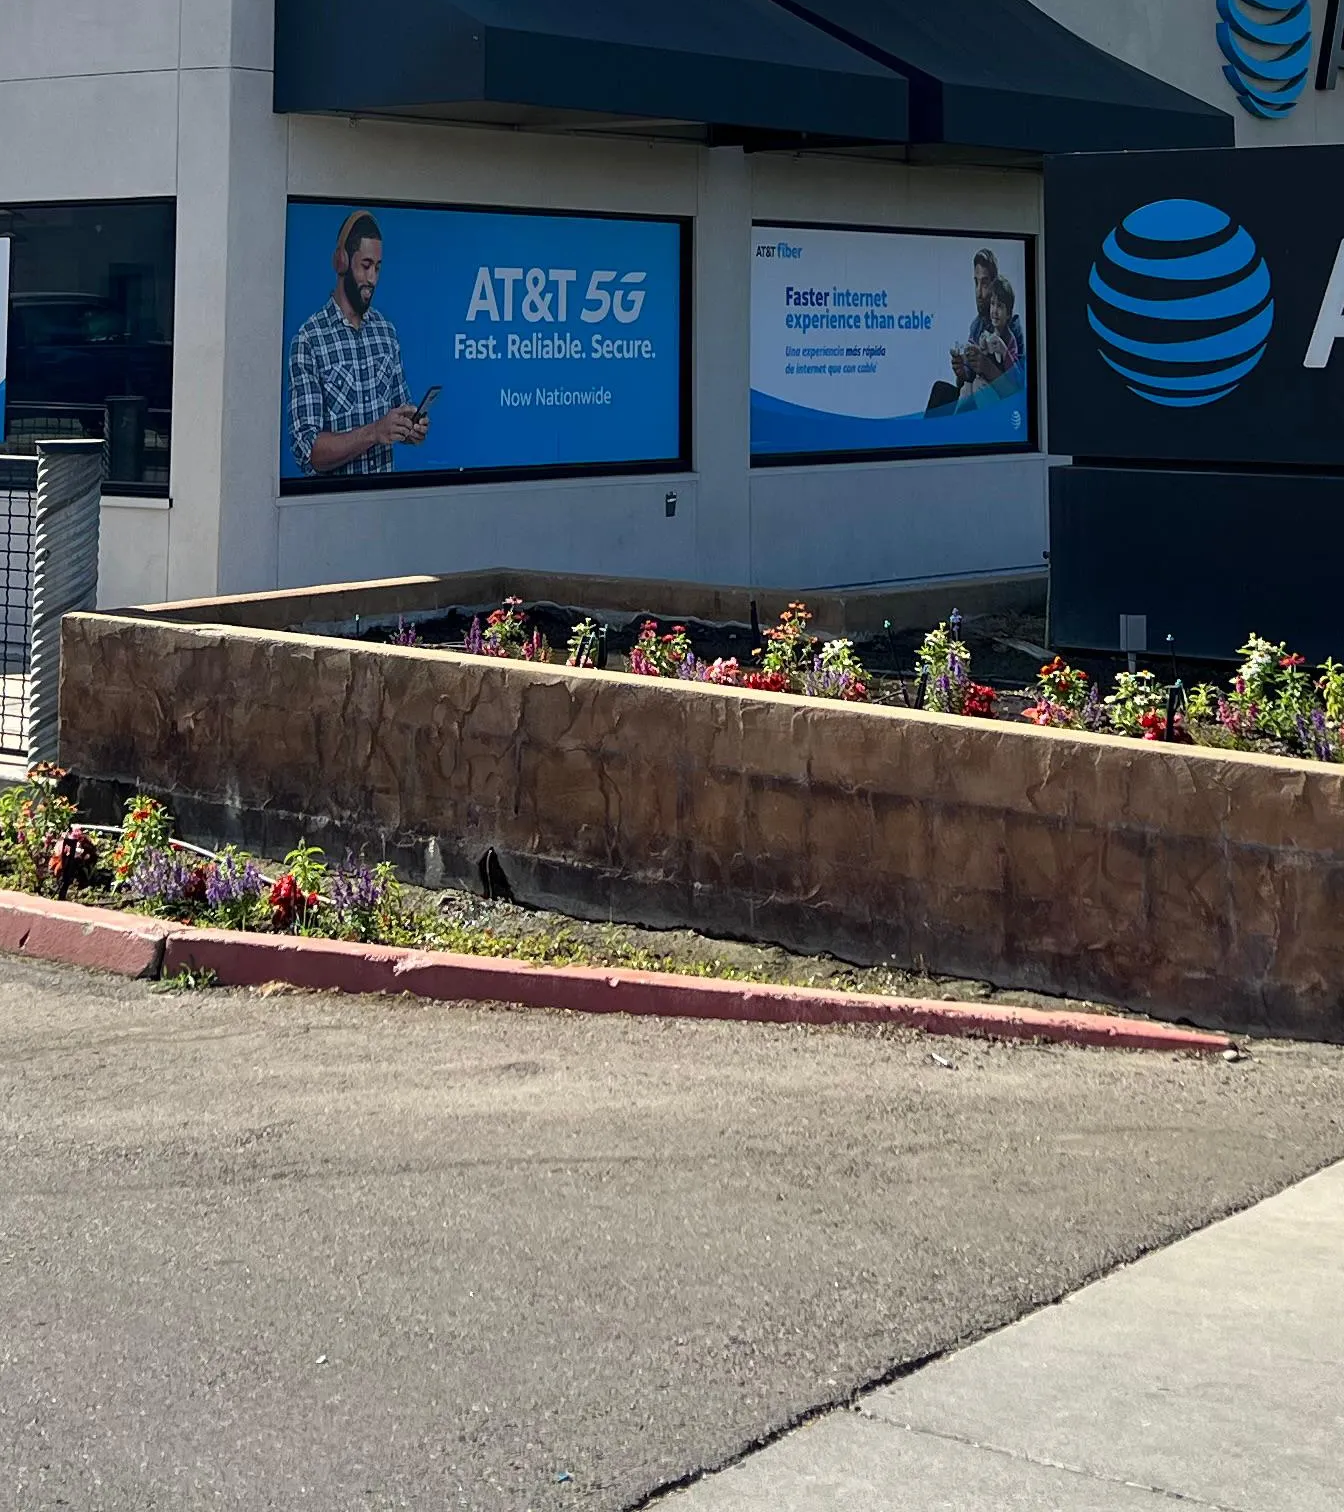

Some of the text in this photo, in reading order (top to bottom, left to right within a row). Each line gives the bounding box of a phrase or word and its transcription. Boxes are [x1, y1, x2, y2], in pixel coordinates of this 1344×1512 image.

[756, 242, 803, 259] AT&T fiber
[465, 266, 647, 323] AT&T 5G
[785, 286, 888, 308] Faster internet
[785, 308, 861, 334] experience
[864, 309, 895, 329] than
[454, 332, 656, 359] Fast. Reliable. Secure.
[785, 346, 801, 357] Una
[802, 345, 845, 359] experiencia
[845, 345, 861, 357] más
[785, 363, 795, 374] de
[796, 362, 827, 374] internet
[828, 364, 841, 376] que
[500, 386, 612, 406] Now Nationwide
